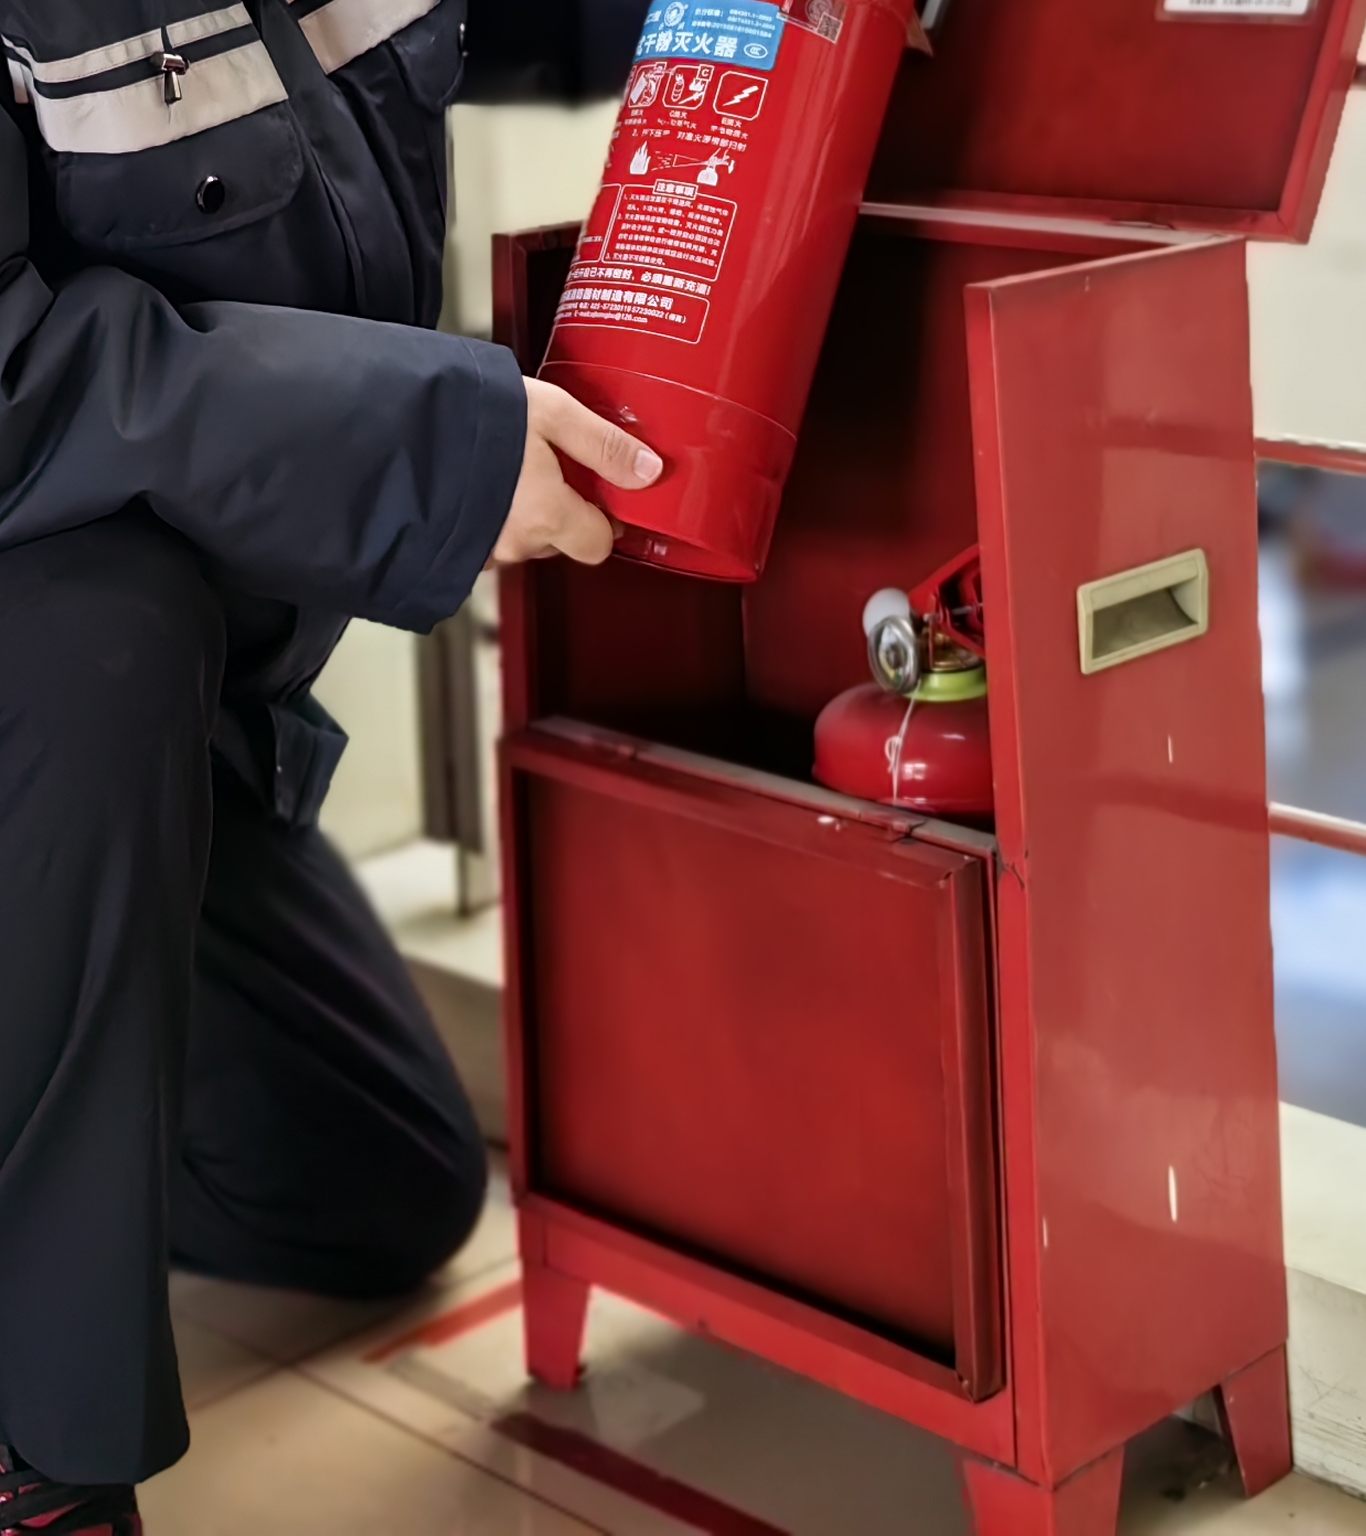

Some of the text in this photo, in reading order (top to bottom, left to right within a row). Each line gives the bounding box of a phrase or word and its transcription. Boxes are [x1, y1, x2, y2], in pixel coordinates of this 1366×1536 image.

[701, 69, 709, 77] C
[656, 182, 695, 197] 注意事项
